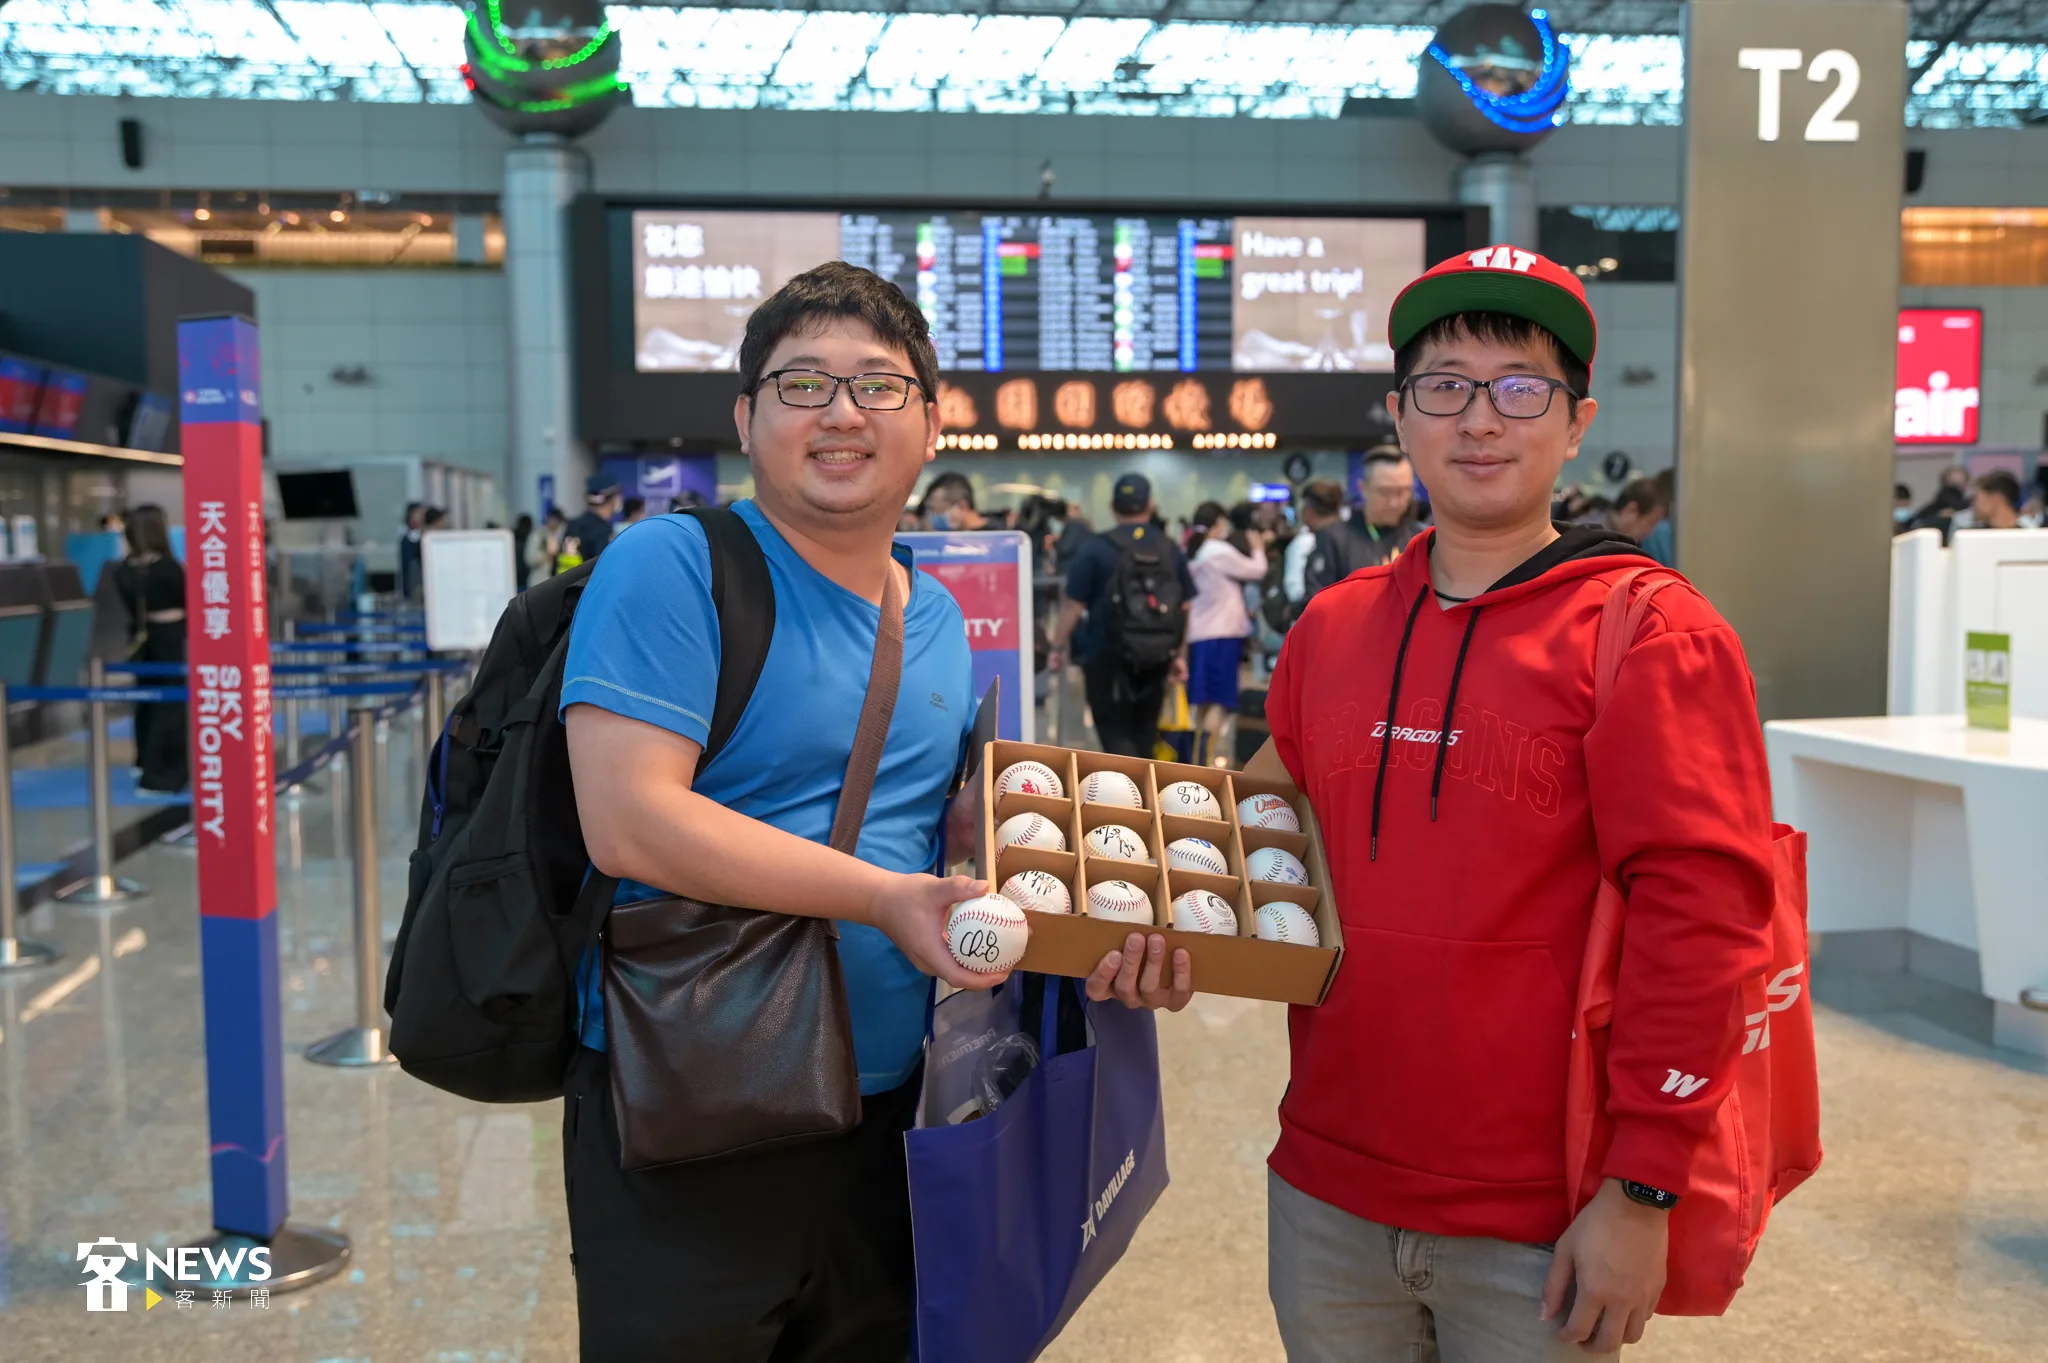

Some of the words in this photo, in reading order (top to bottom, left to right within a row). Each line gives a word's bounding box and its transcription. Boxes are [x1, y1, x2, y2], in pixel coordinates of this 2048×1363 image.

[1738, 47, 1860, 142] T2
[1242, 231, 1303, 257] Have
[1307, 237, 1324, 257] a
[1241, 269, 1306, 300] great
[1311, 267, 1363, 300] trip!
[1895, 370, 1980, 437] air
[219, 665, 243, 741] SKY
[196, 664, 225, 839] PRIORITY
[1095, 1148, 1136, 1221] DAVILLAGE
